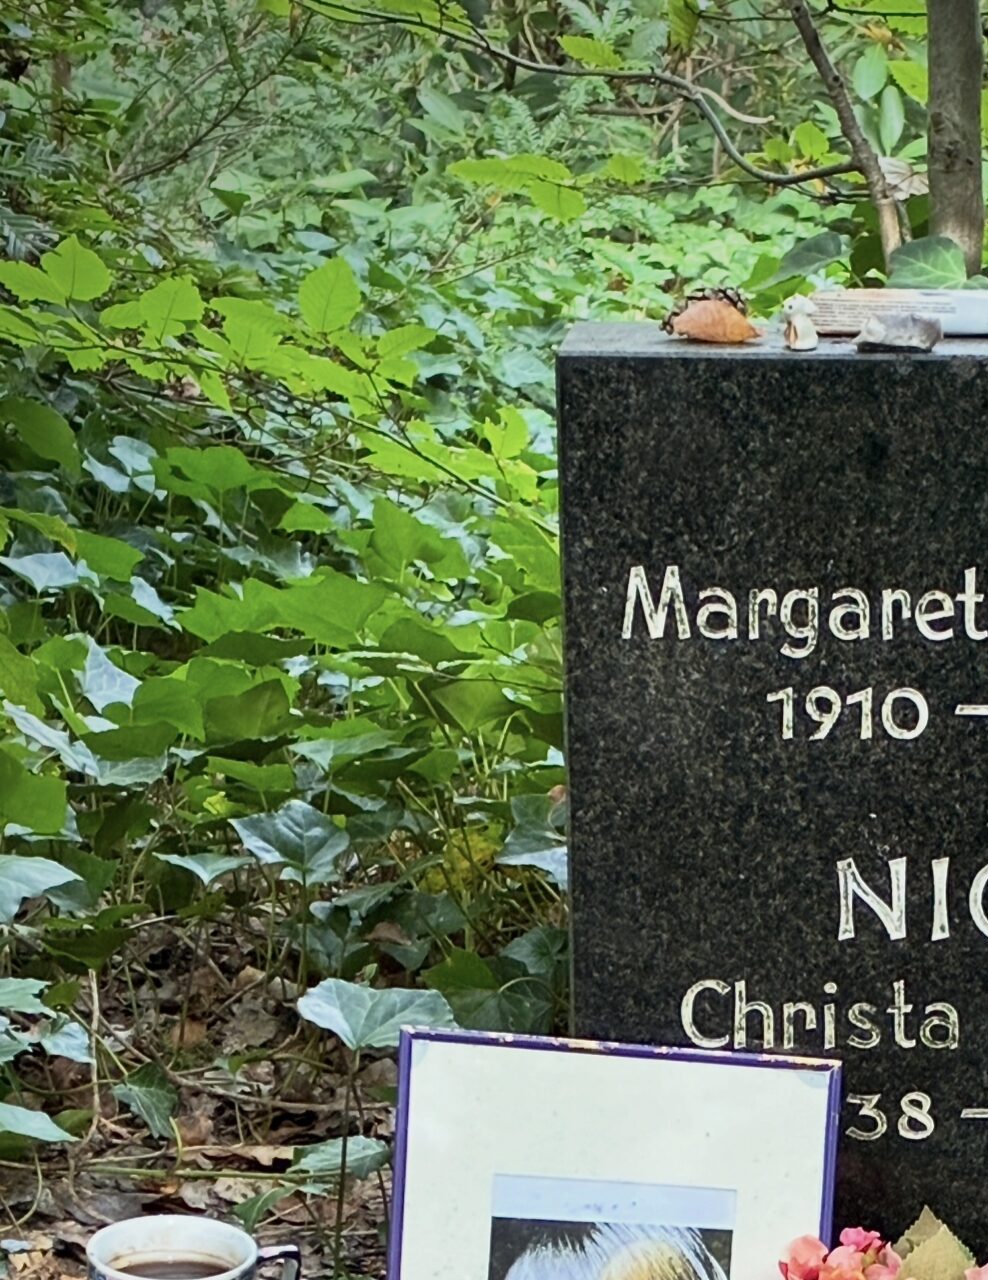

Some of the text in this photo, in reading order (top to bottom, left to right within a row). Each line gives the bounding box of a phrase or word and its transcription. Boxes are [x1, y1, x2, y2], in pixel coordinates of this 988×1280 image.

[766, 685, 930, 741] 1910
[680, 979, 960, 1050] Christa
[845, 1091, 935, 1141] 38
